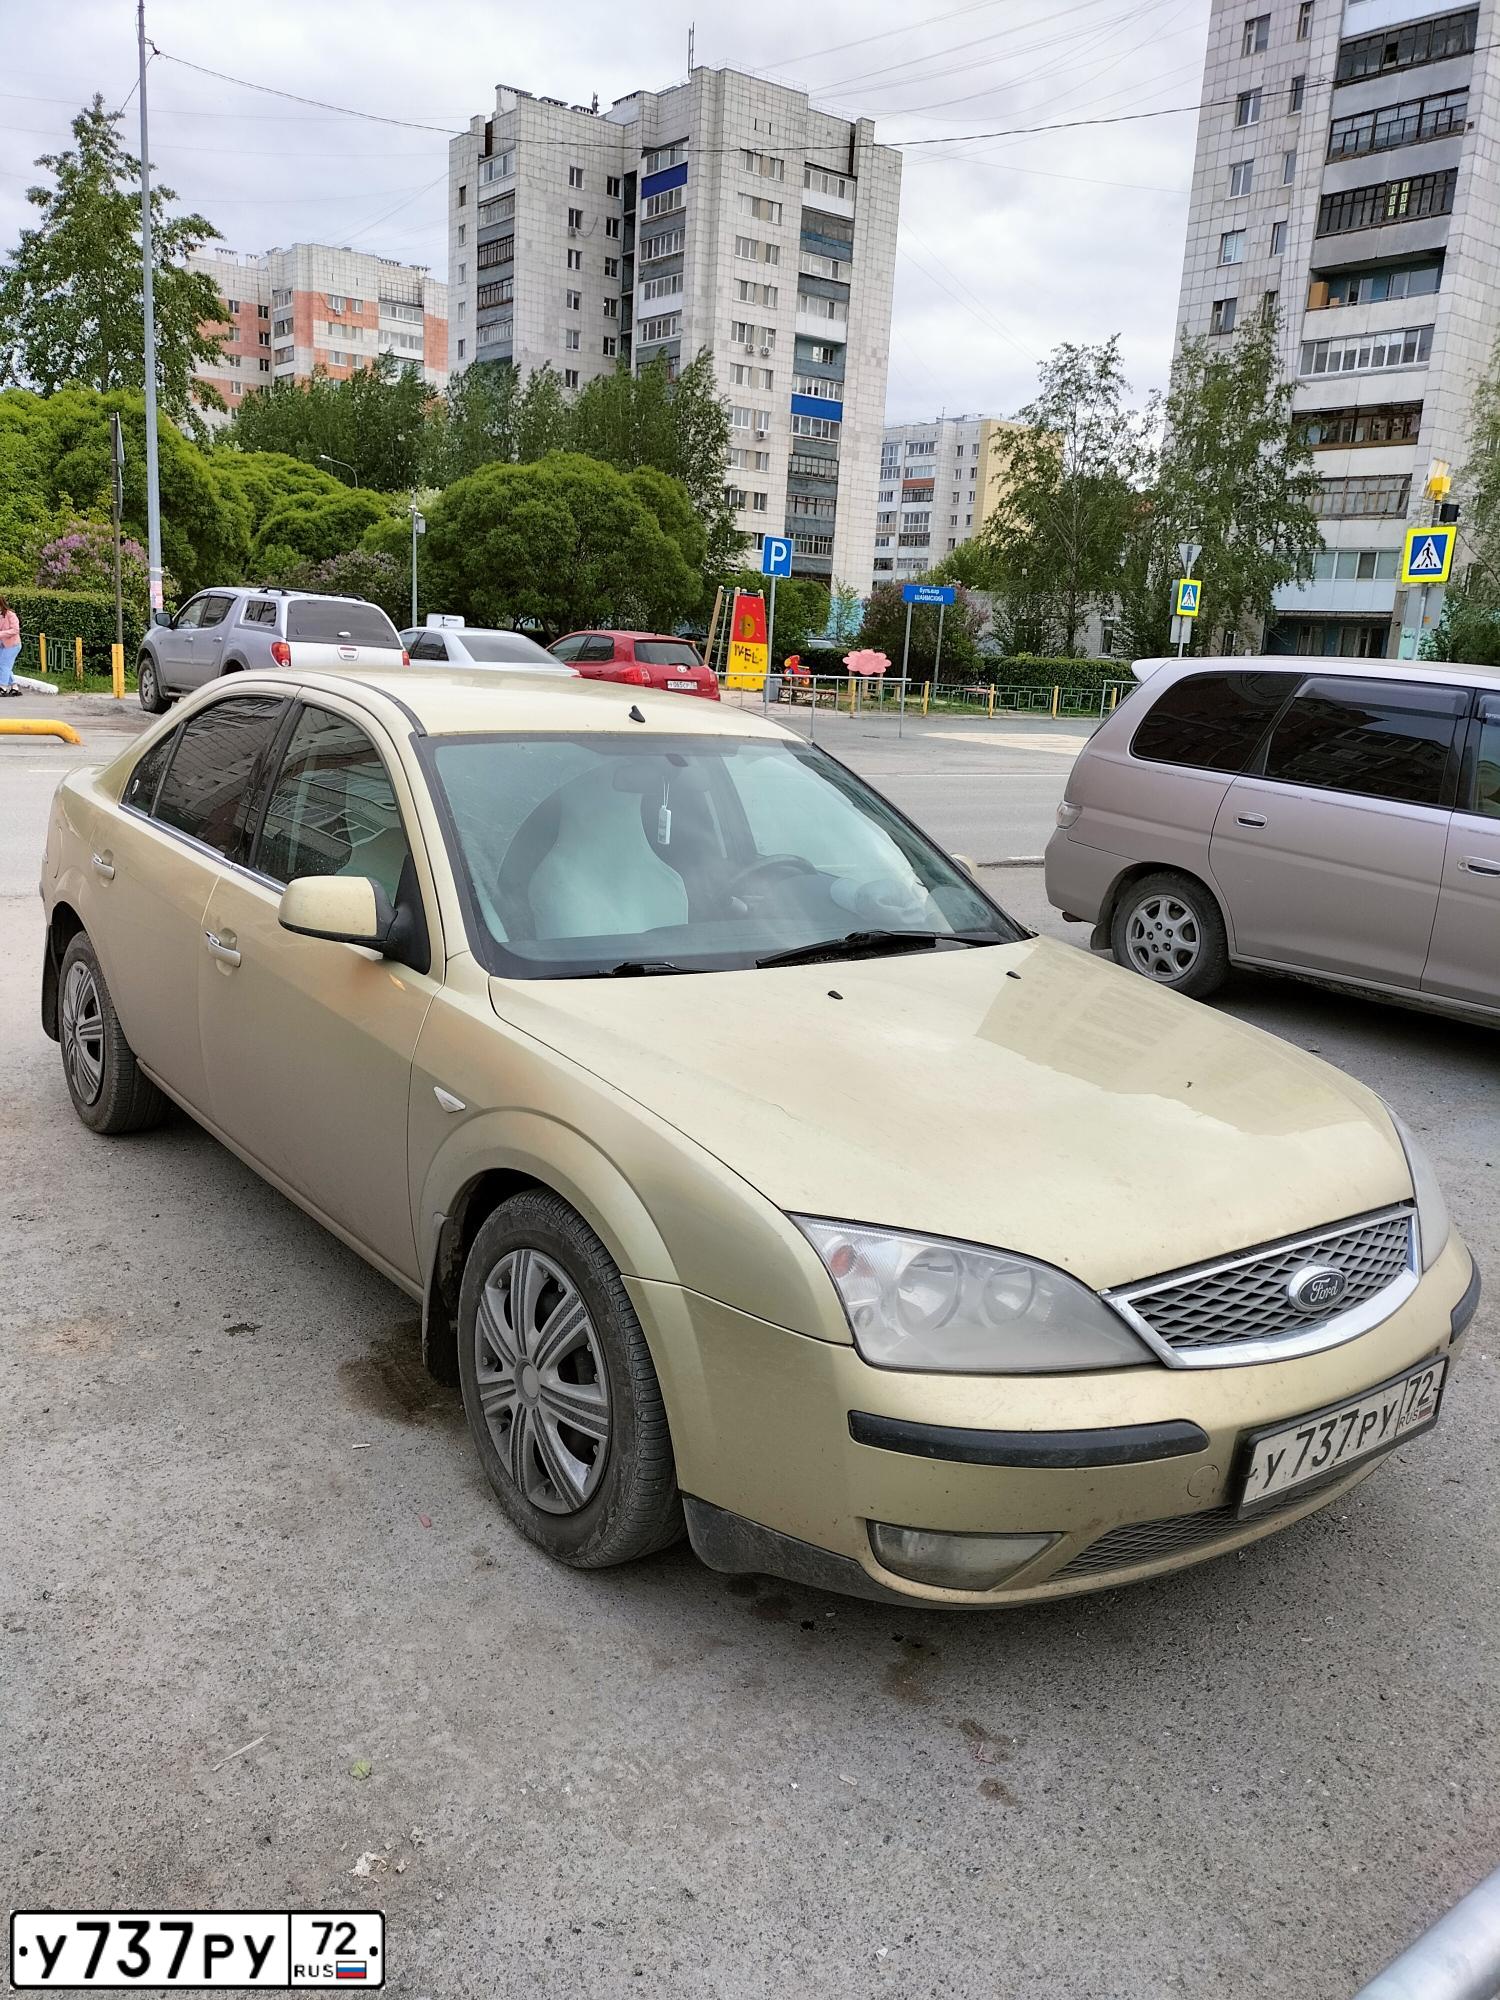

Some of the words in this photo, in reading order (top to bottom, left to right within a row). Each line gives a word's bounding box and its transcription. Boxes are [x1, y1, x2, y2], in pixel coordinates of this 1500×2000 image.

[770, 541, 787, 571] P
[1310, 1278, 1338, 1302] Ford
[1406, 1370, 1434, 1413] 72
[1399, 1410, 1419, 1427] RUS
